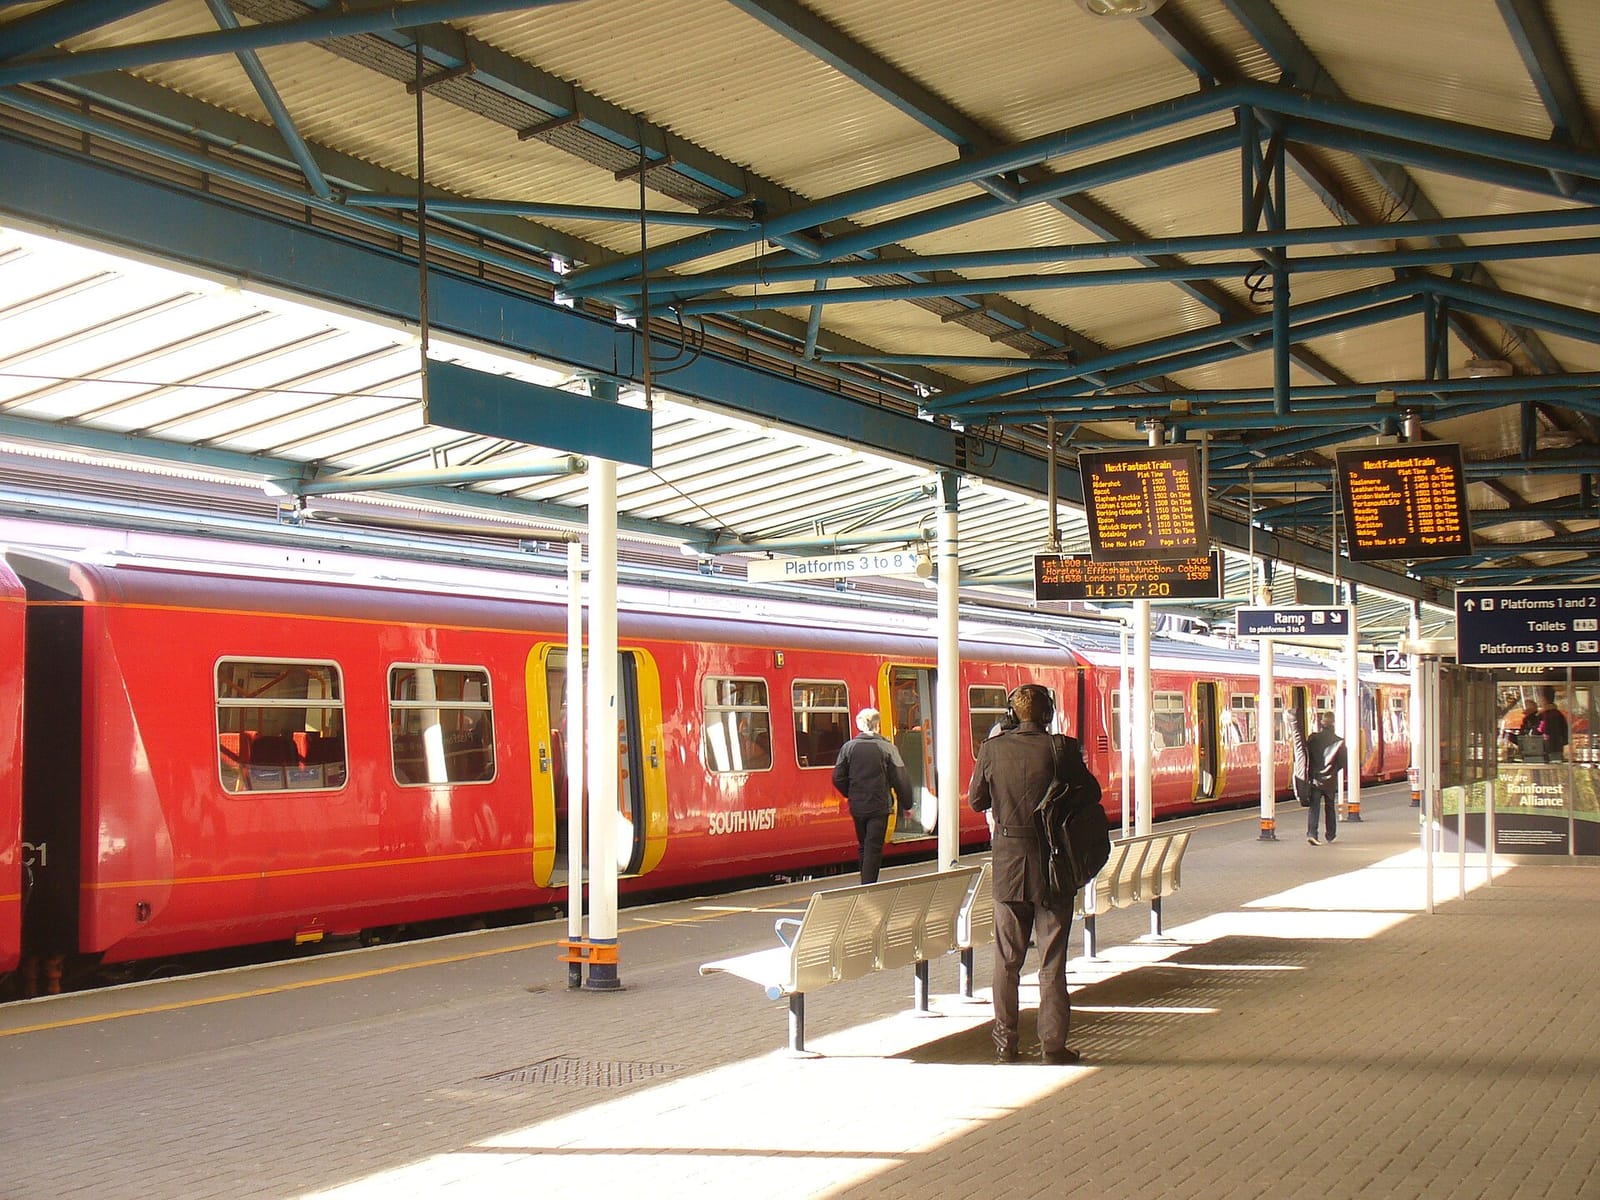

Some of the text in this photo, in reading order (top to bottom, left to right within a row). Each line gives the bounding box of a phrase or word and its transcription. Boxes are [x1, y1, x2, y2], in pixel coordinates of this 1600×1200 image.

[1105, 461, 1171, 472] Next Fastest Train
[1364, 458, 1435, 469] Next Fastest Train
[785, 555, 902, 574] Platforms 3 to 8
[1085, 583, 1170, 596] 14:57:20
[1501, 597, 1596, 609] Platforms 1 and 2
[1274, 613, 1305, 625] Ramp
[1528, 621, 1566, 631] Toilets
[1480, 642, 1569, 654] Platforms 3 to 8
[1507, 783, 1563, 793] Rainforest
[1520, 795, 1563, 806] Alliance
[709, 810, 747, 835] SOUTH
[748, 808, 776, 831] WEST
